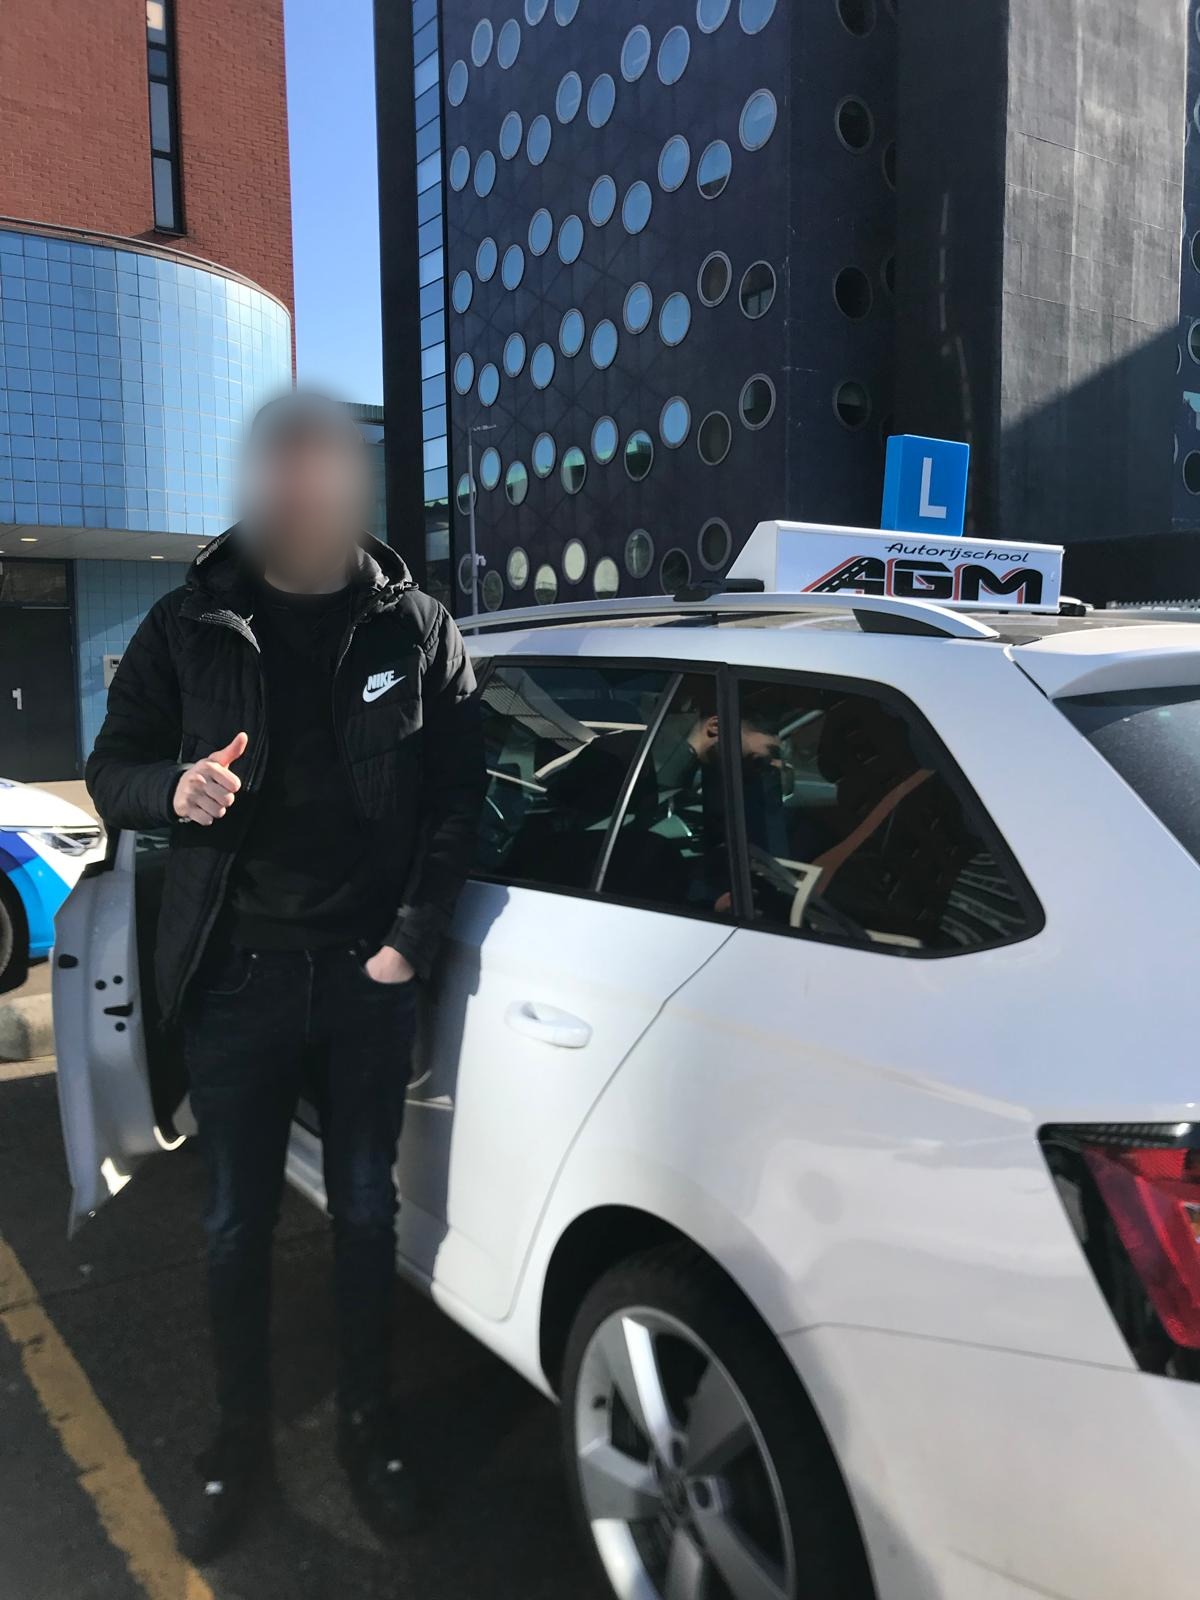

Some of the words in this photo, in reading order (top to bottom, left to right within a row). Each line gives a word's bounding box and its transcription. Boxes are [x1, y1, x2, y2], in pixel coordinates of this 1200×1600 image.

[919, 457, 947, 519] L
[884, 542, 1029, 563] Autorijschool
[801, 555, 1043, 605] AGM
[367, 669, 395, 691] NIKE
